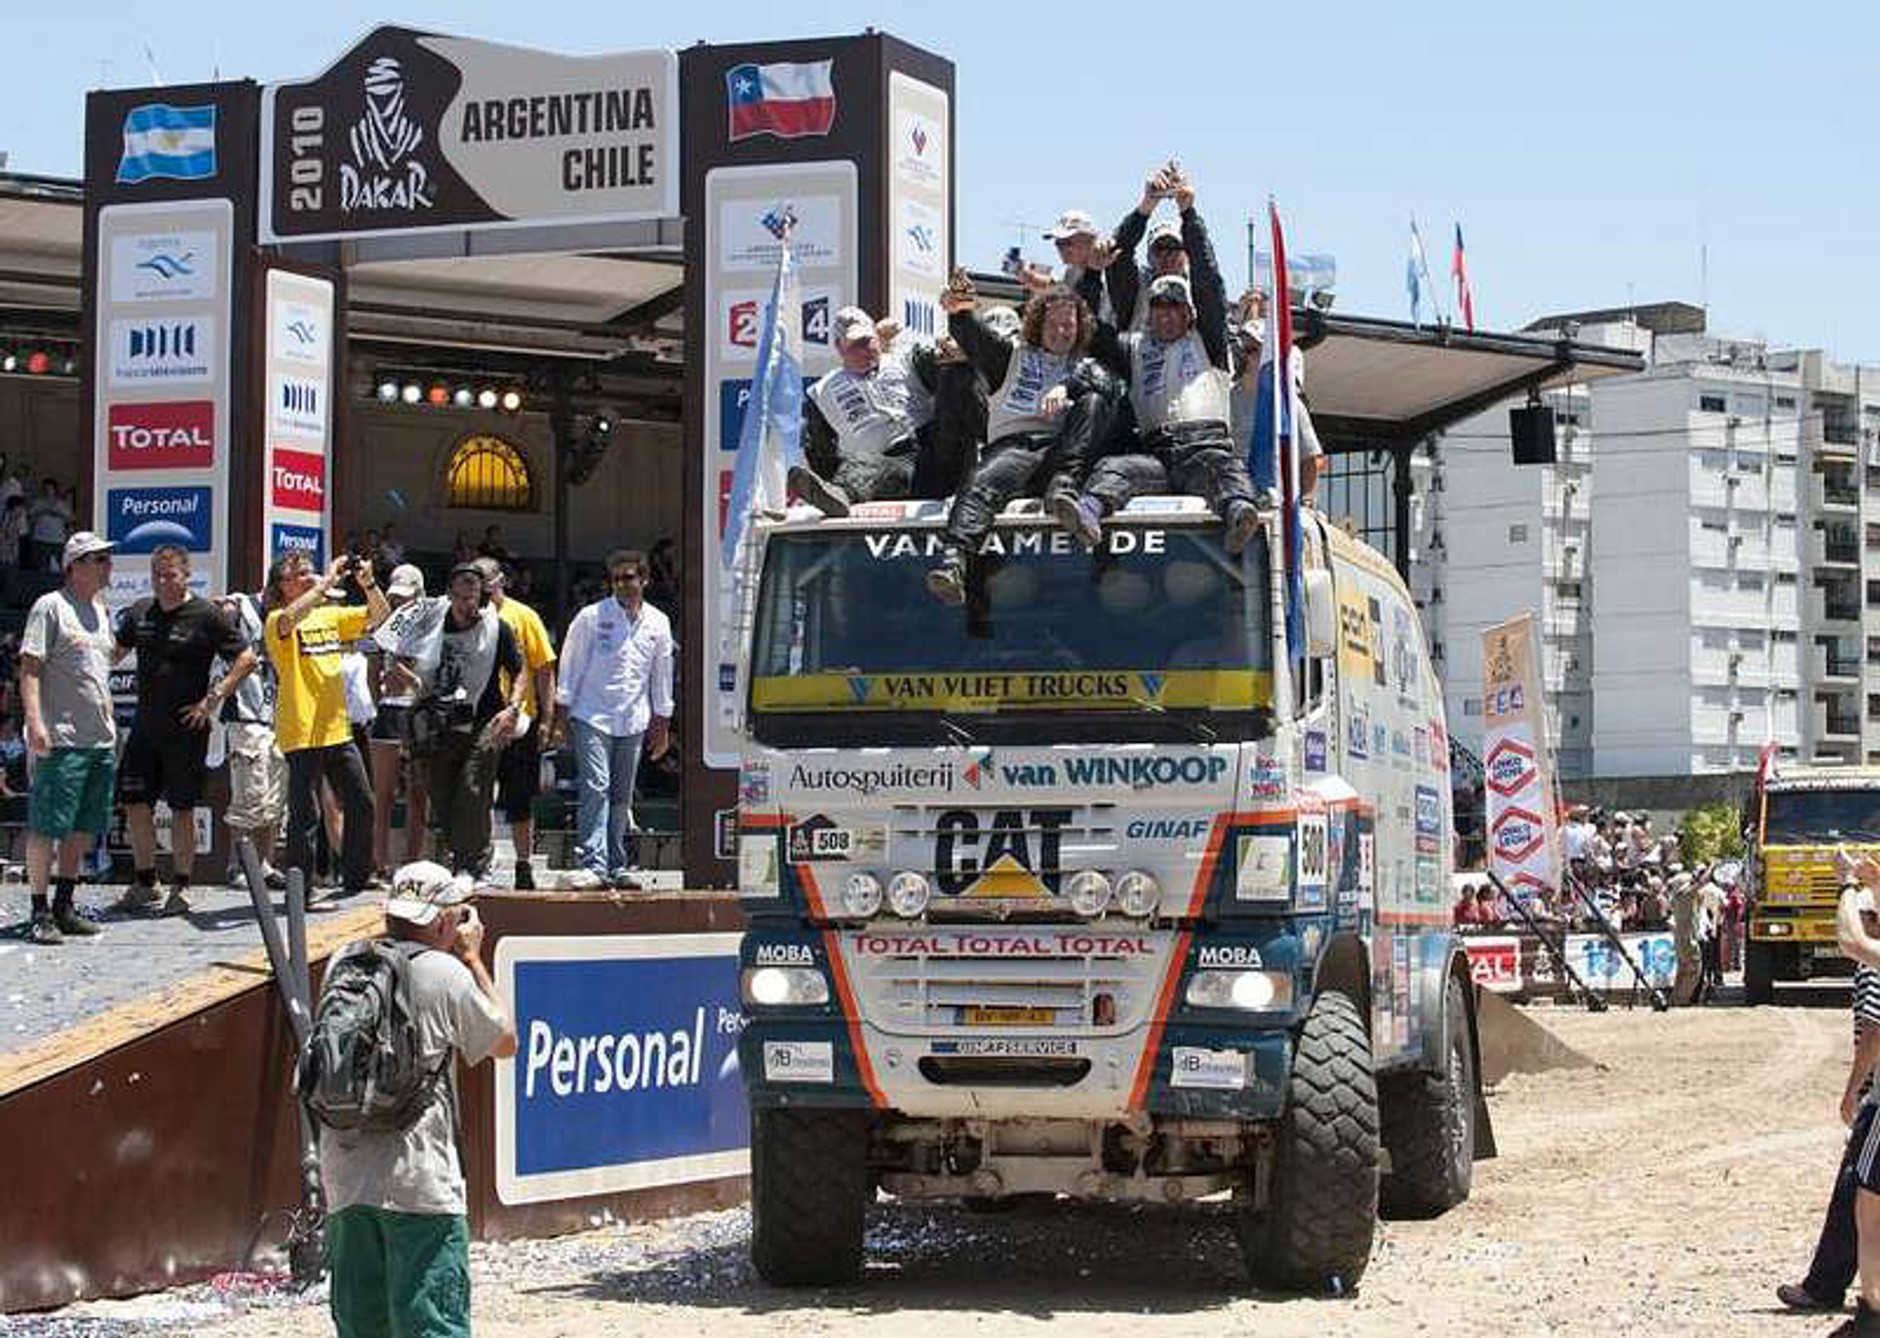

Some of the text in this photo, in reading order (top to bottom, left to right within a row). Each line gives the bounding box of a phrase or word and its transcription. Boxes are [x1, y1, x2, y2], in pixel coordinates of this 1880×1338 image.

[461, 87, 655, 143] ARGENTINA
[291, 106, 324, 211] 2010
[562, 144, 655, 192] CHILE
[340, 163, 433, 211] DAKAR
[807, 309, 828, 339] 4
[113, 423, 211, 449] TOTAL
[274, 468, 323, 495] TOTAL
[122, 494, 198, 516] Personal
[279, 532, 318, 551] Personal
[978, 528, 1166, 555] AMEDE
[884, 674, 1128, 698] VAN VLIET TRUCKS
[790, 763, 953, 794] Autospuiterij
[1001, 764, 1056, 787] van
[1063, 756, 1228, 785] WINKOOP
[818, 832, 850, 850] 508
[1126, 820, 1209, 839] GINAF
[935, 810, 1073, 896] CAT
[757, 944, 813, 962] MOBA
[853, 935, 1155, 954] TOTAL TOTAL TOTAL
[1199, 947, 1262, 965] MOBA
[526, 1006, 706, 1098] Personal
